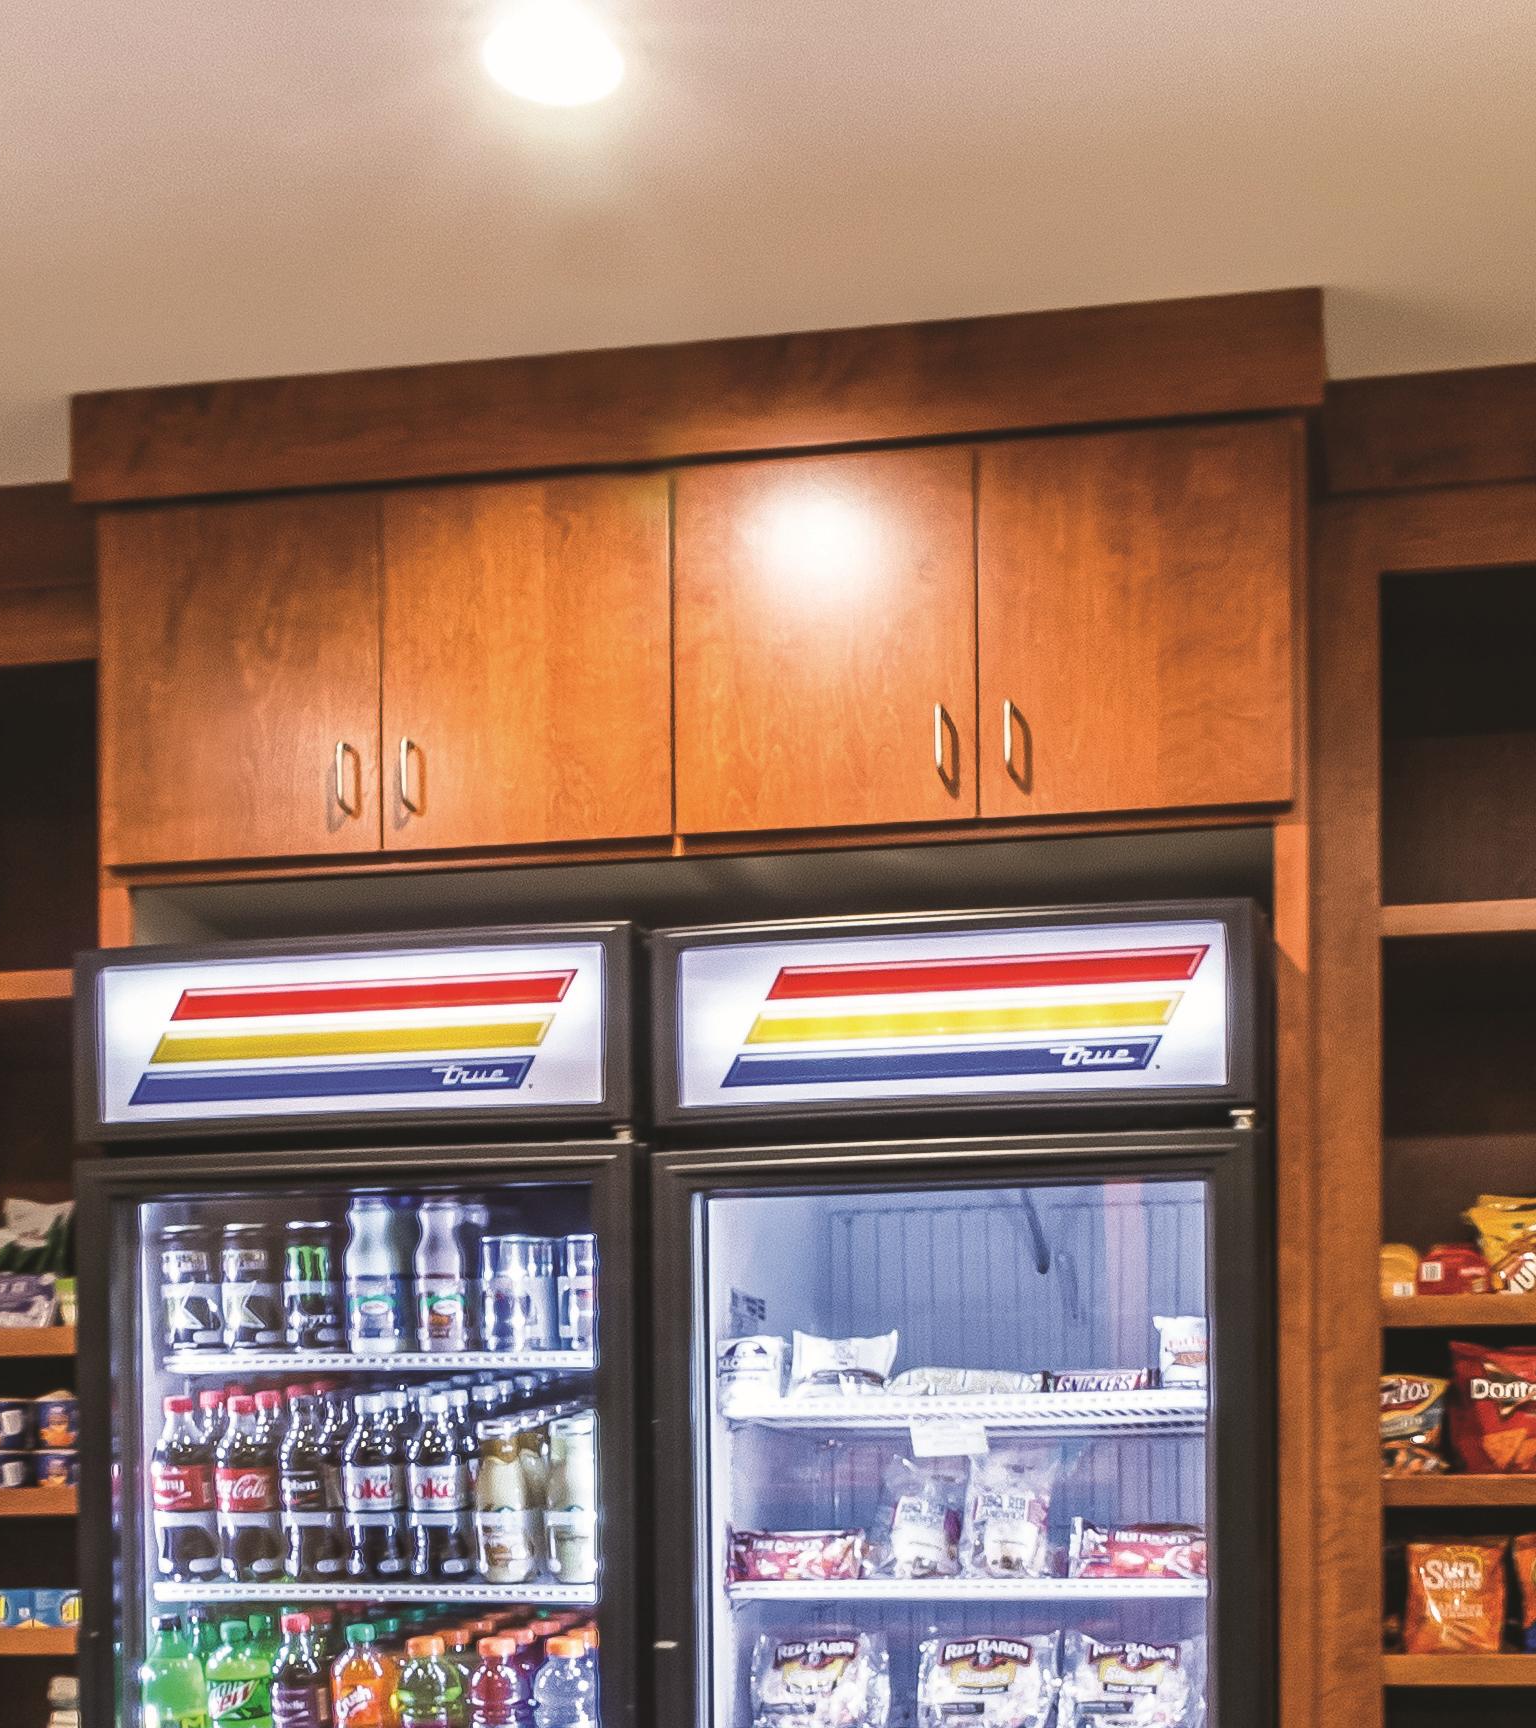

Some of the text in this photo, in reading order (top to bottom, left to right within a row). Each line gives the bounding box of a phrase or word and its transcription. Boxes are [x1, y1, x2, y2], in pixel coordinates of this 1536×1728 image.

[1049, 1044, 1136, 1067] true
[431, 1064, 510, 1087] true
[1059, 1375, 1133, 1392] SNICKERS
[944, 1639, 1028, 1661] RED BARON
